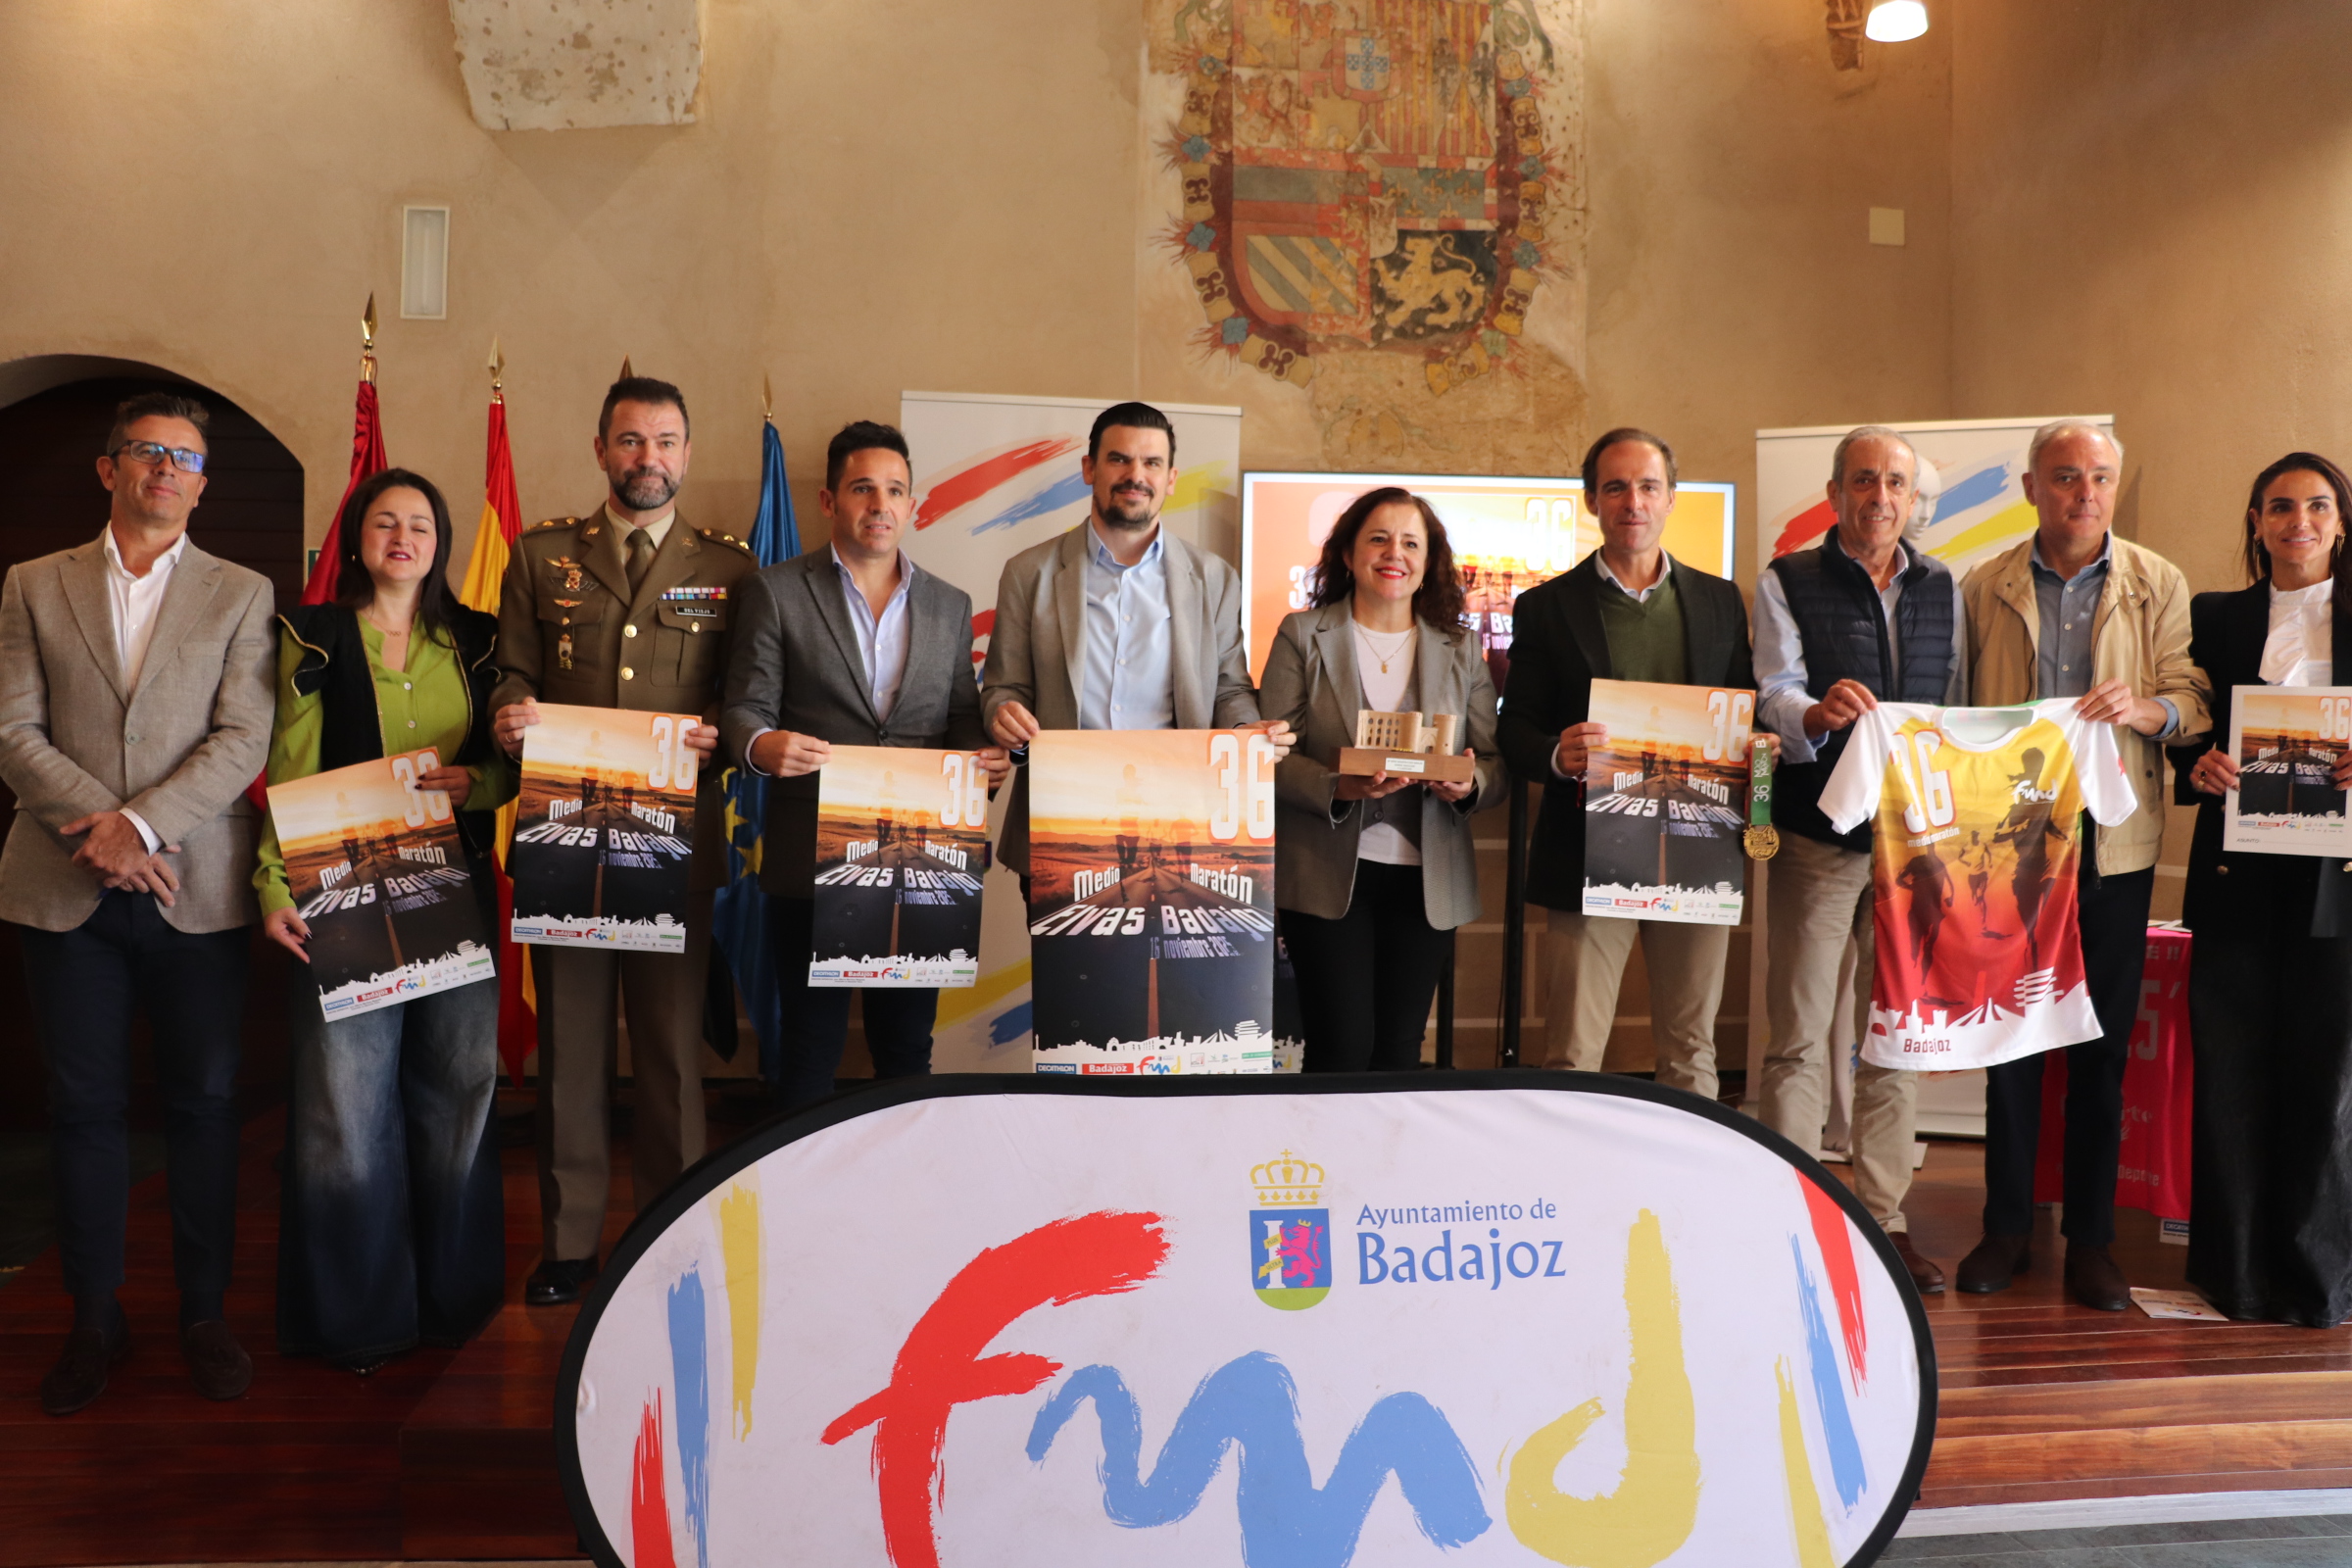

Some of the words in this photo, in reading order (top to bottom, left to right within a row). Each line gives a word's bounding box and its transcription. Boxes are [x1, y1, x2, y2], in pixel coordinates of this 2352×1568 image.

[1525, 498, 1573, 571] 36
[1703, 691, 1752, 761] 36
[2320, 697, 2350, 740] 36
[649, 716, 699, 790] 36
[392, 751, 451, 828] 36
[940, 754, 988, 827] 36
[1210, 734, 1275, 839] 36
[1613, 771, 1643, 792] Medio
[1688, 773, 1729, 805] Maratón
[1753, 785, 1770, 802] 36
[549, 799, 582, 820] Medio
[631, 801, 676, 834] Maratón
[1586, 793, 1658, 817] Elvas
[1668, 799, 1744, 830] Badajoz
[515, 822, 598, 848] Elvas
[608, 828, 692, 861] Badajoz
[846, 840, 879, 862] Medio
[925, 840, 967, 871] Maratón
[319, 860, 352, 890] Medio
[398, 841, 447, 865] Maratón
[814, 863, 894, 887] Elvas
[904, 867, 983, 896] Badajoz
[1074, 866, 1121, 902] Medio
[1191, 862, 1253, 905] Maratón
[298, 883, 376, 920] Elvas
[383, 866, 470, 899] Badajoz
[1030, 904, 1146, 936] Elvas
[1161, 905, 1275, 942] Badajoz
[1163, 937, 1215, 958] noviembre
[1903, 1039, 1951, 1054] Badajoz
[1356, 1202, 1523, 1229] Ayuntamiento
[1530, 1198, 1556, 1219] de
[1356, 1228, 1566, 1291] Badajoz
